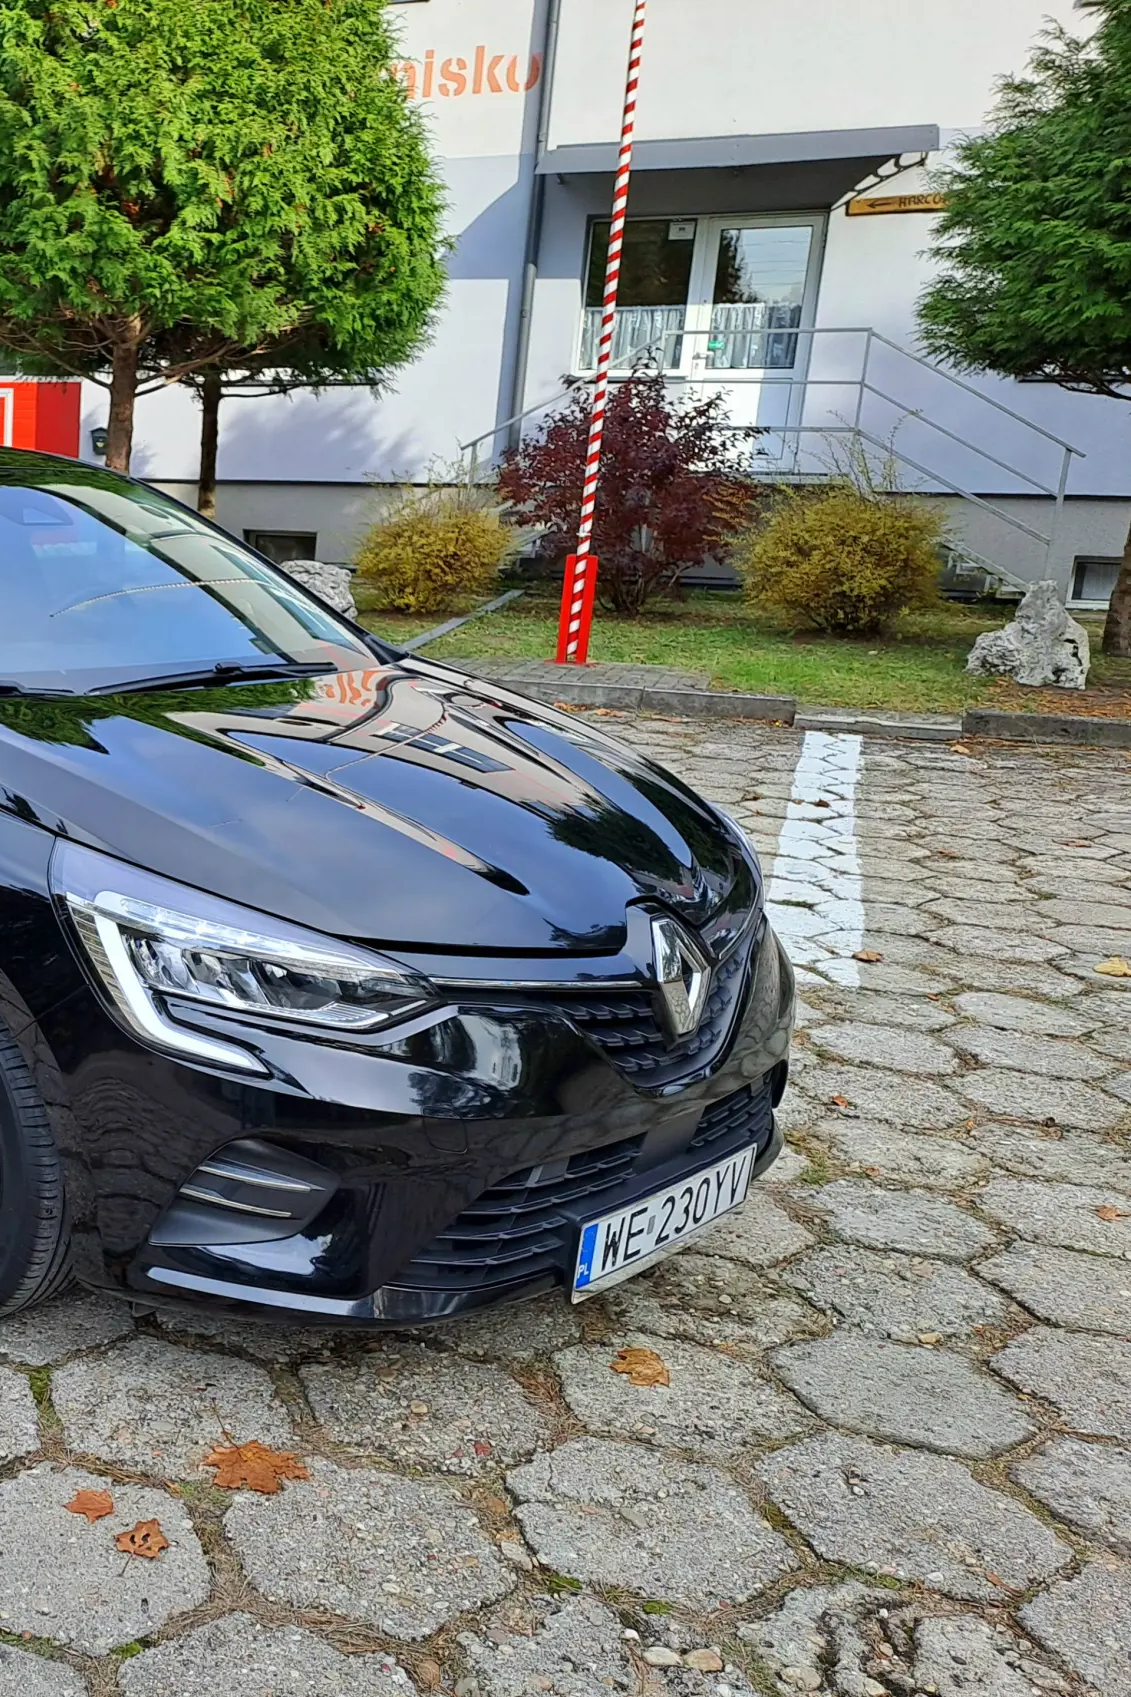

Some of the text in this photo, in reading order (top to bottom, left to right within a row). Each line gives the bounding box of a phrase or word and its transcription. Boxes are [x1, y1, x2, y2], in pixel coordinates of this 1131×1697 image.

[390, 45, 544, 100] nisko
[601, 1155, 747, 1273] WE 230YV
[578, 1265, 590, 1279] PL
